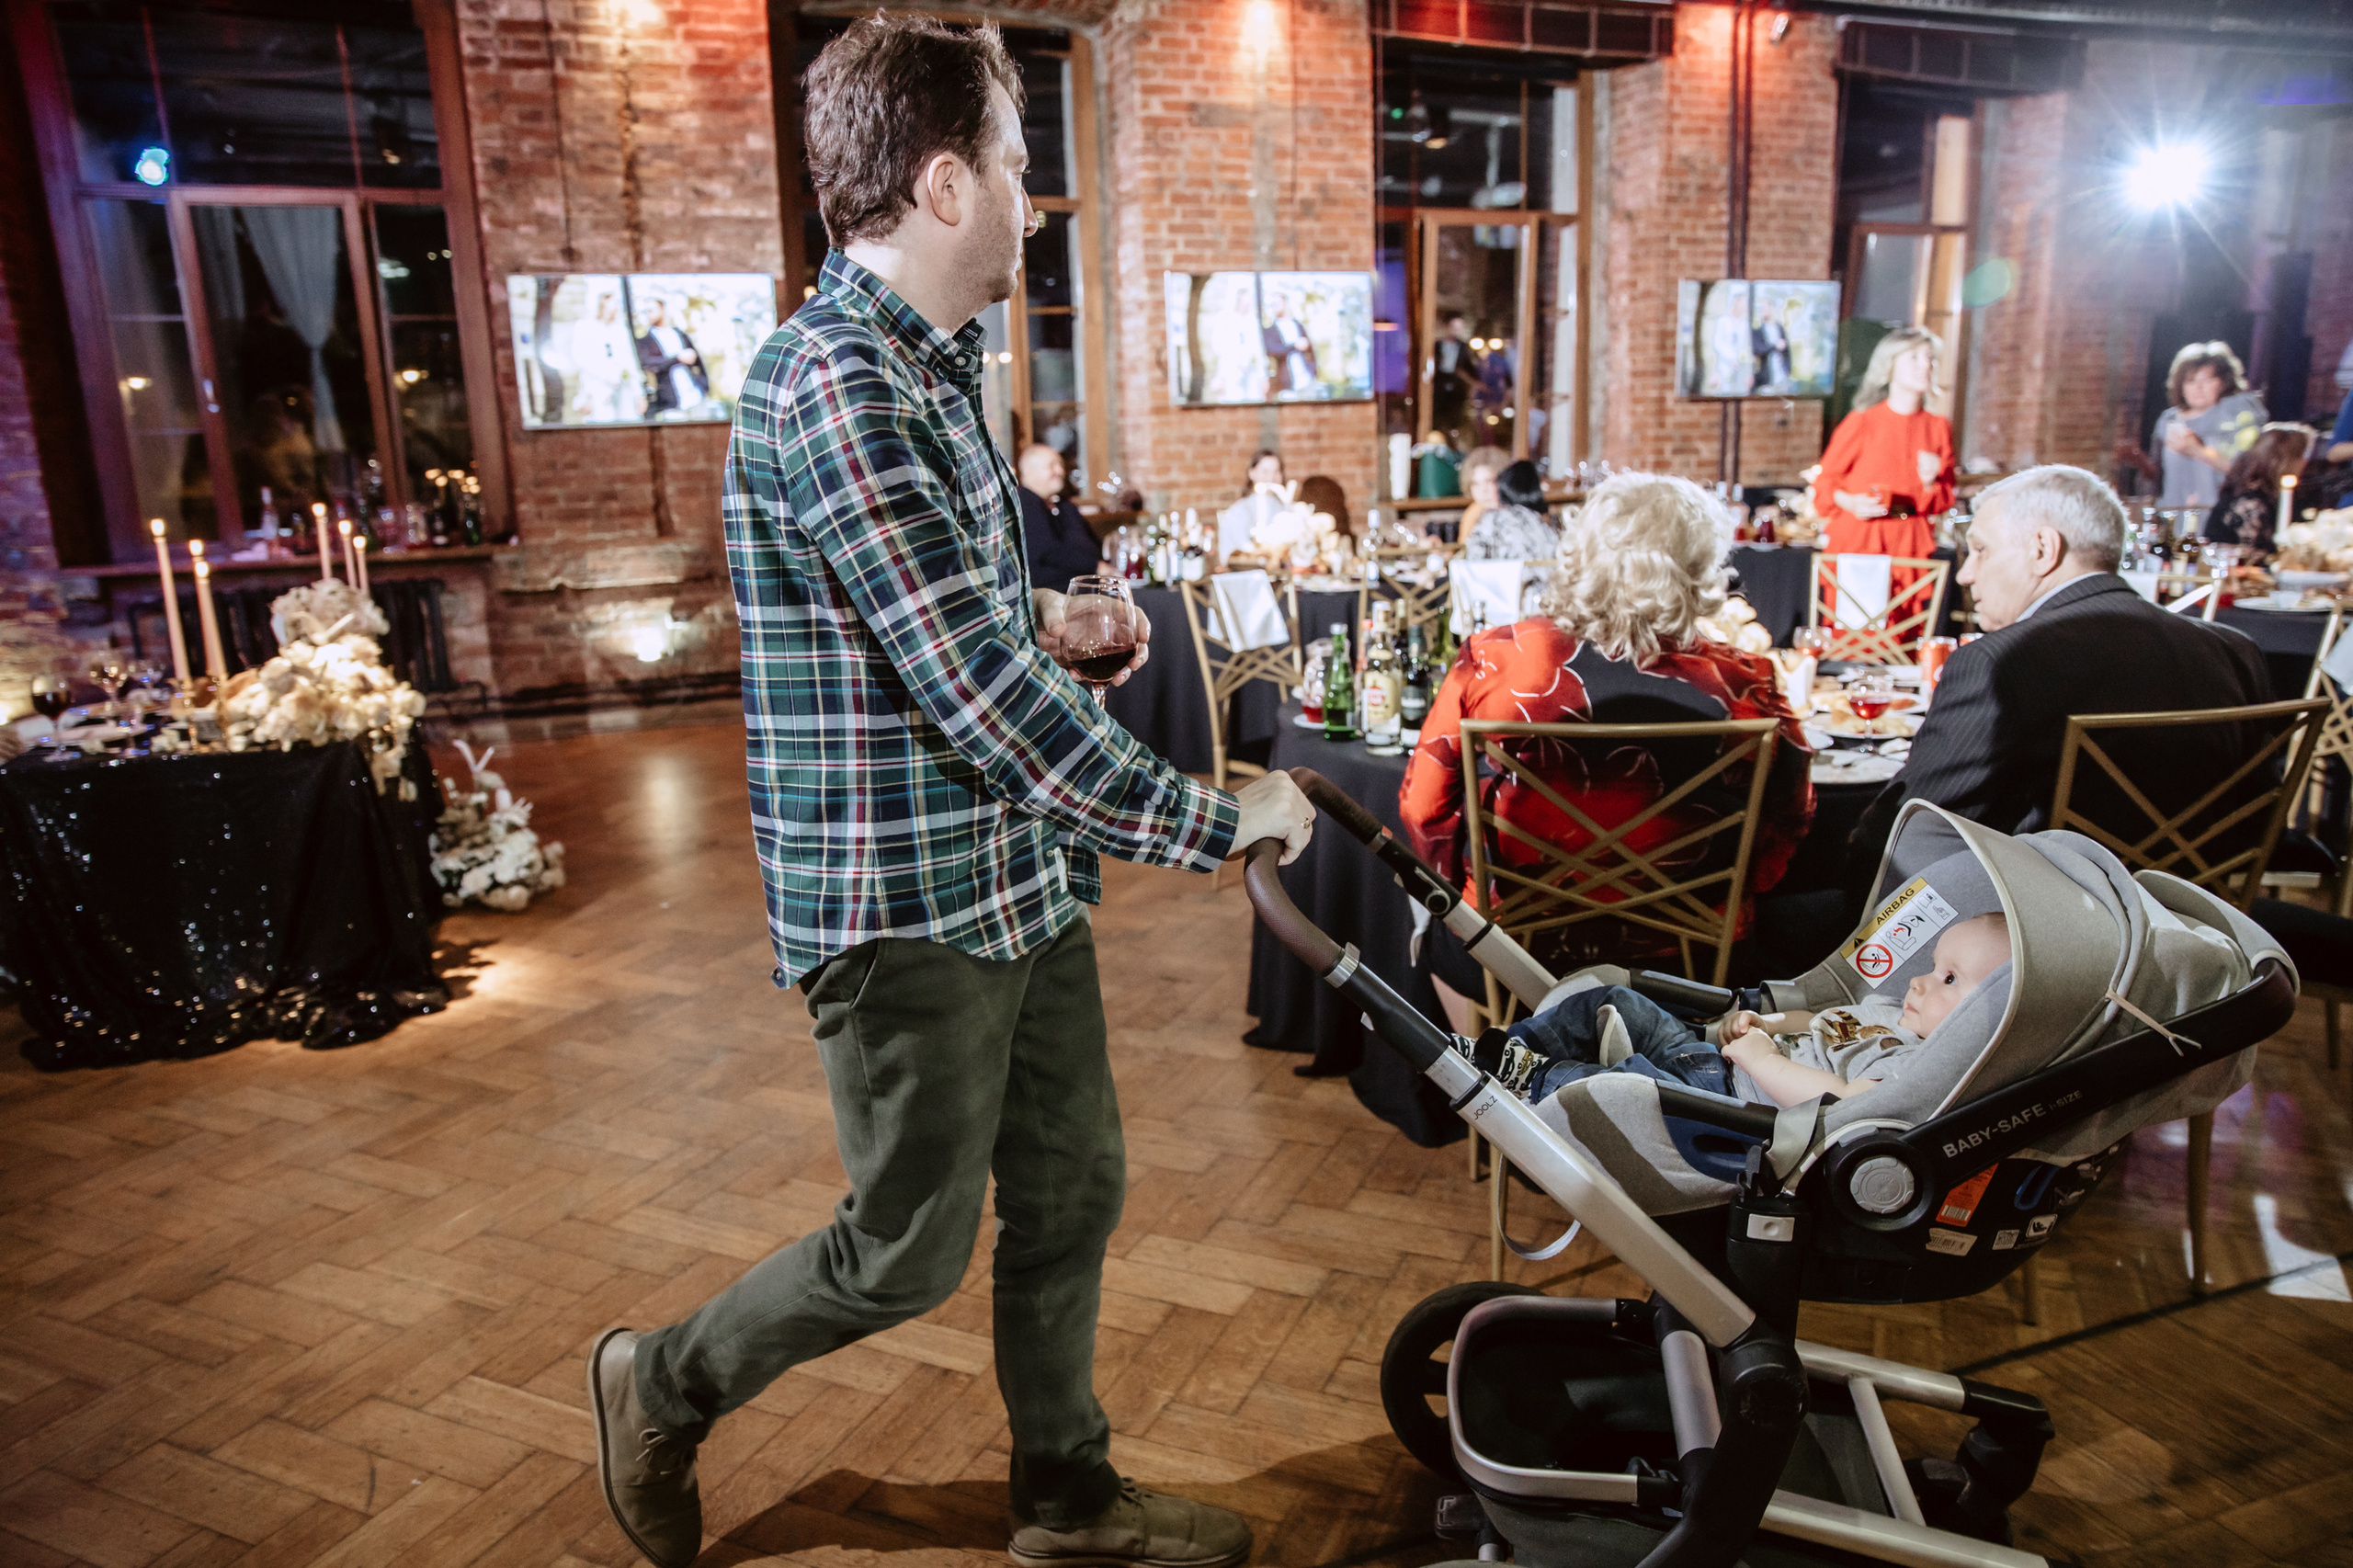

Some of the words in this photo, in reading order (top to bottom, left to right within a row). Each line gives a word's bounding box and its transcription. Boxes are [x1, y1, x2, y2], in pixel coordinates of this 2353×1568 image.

[1876, 887, 1915, 926] AIRBAG
[1473, 1095, 1499, 1120] JOOLZ
[1942, 1104, 2047, 1159] BABY-SAFE
